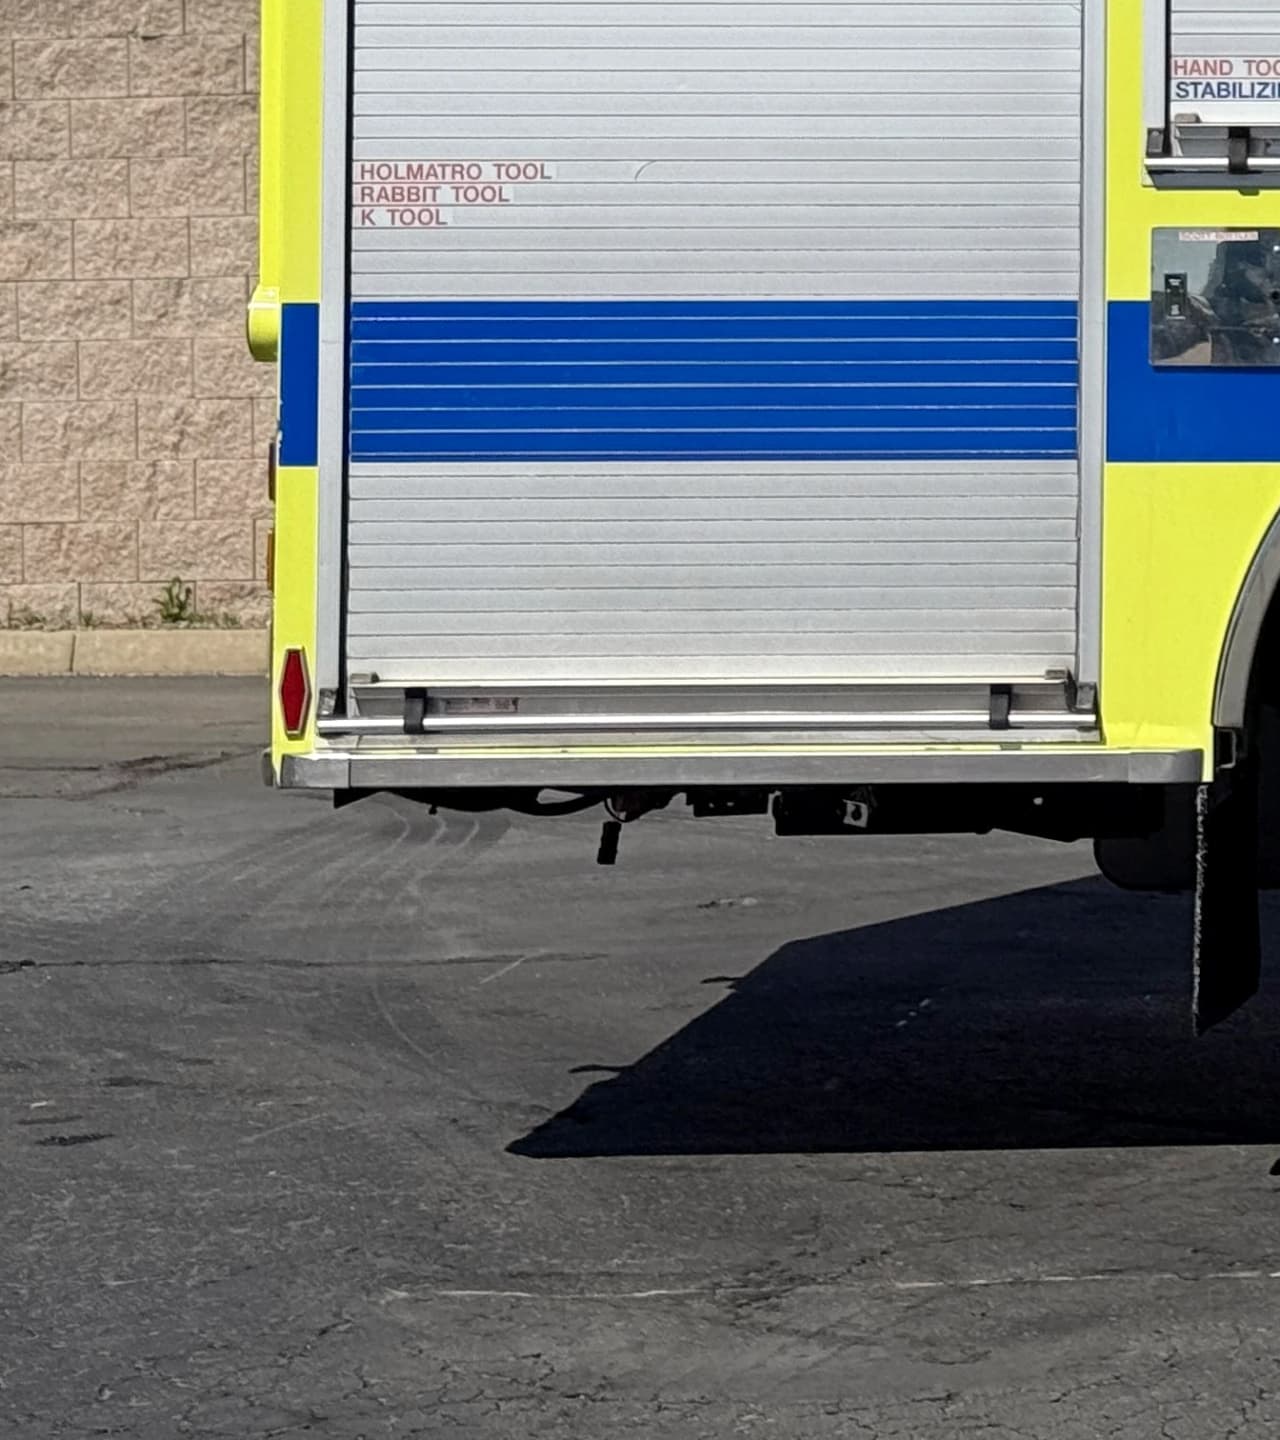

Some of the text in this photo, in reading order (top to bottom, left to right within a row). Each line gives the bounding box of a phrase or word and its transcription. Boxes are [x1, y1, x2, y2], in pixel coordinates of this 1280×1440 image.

[1173, 59, 1234, 76] HAND
[360, 163, 552, 180] HOLMATRO TOOL
[360, 186, 510, 203] RABBIT TOOL
[360, 208, 448, 226] K TOOL
